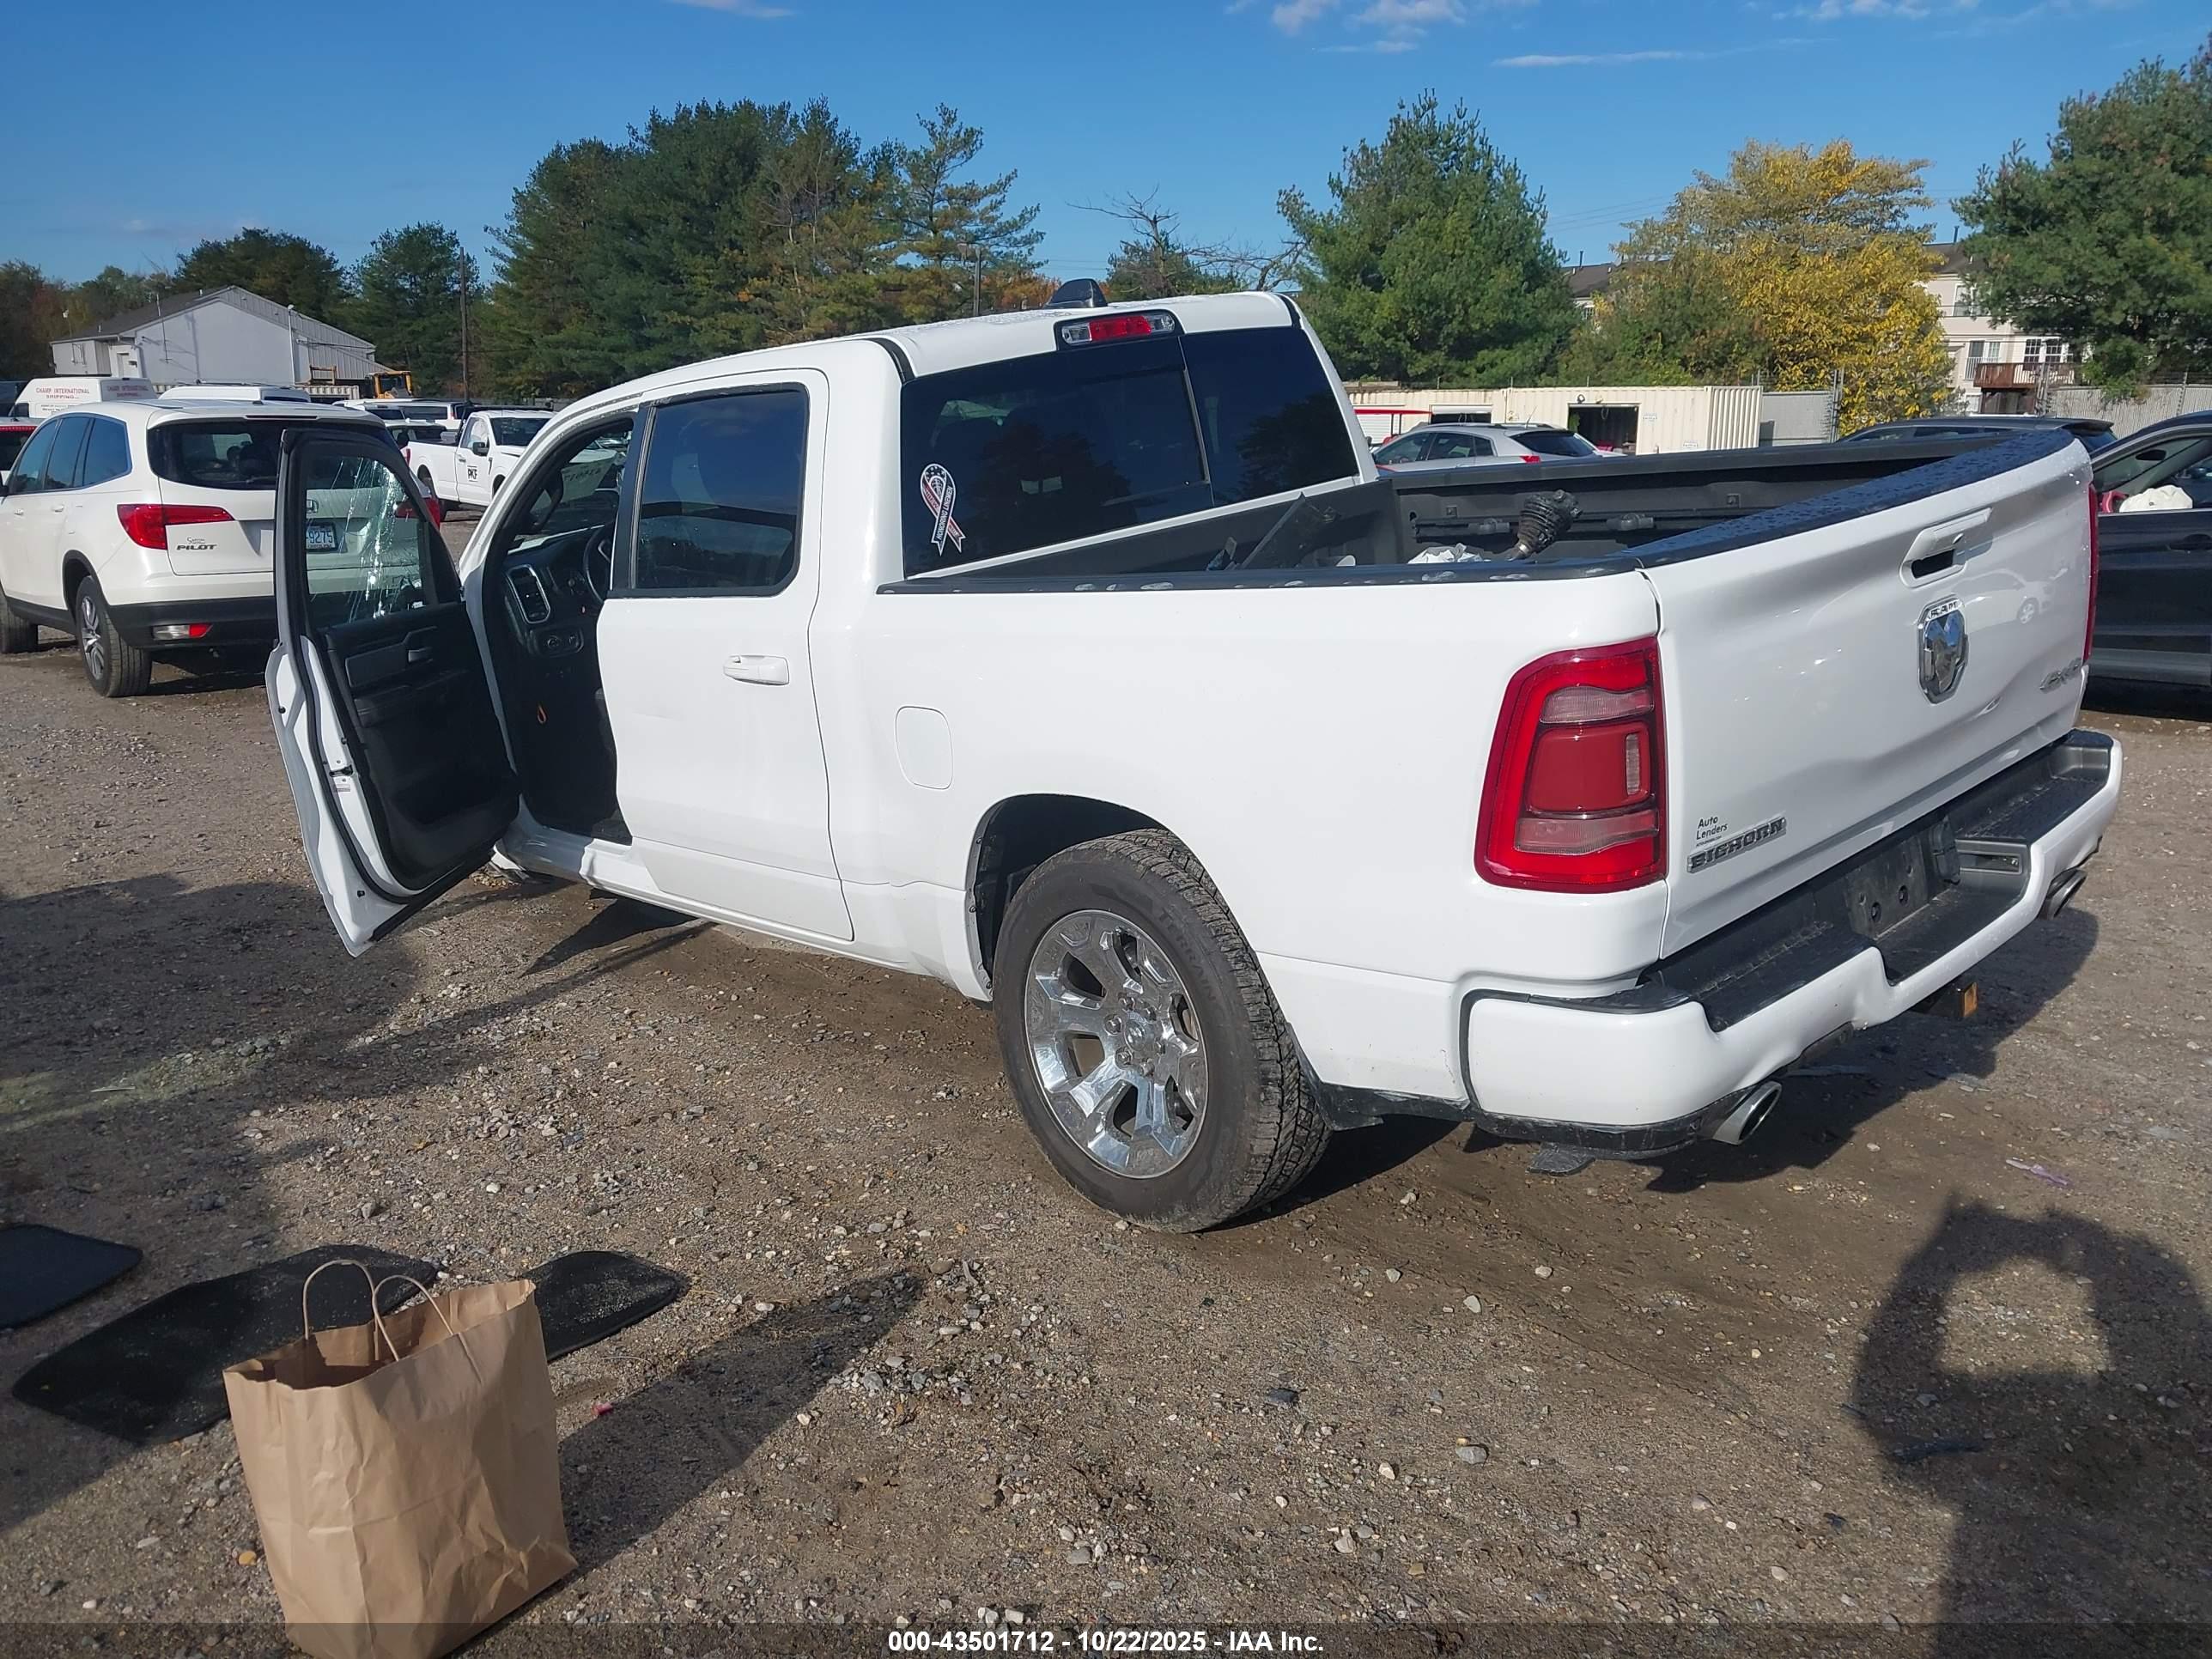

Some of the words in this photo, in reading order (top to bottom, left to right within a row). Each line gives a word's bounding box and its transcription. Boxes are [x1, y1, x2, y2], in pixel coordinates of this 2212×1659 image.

[936, 510, 948, 540] HONORING
[1929, 600, 1959, 617] RAM
[1696, 823, 1729, 840] Lenders
[1698, 817, 1718, 830] Auto
[1689, 817, 1787, 871] BIGHORN
